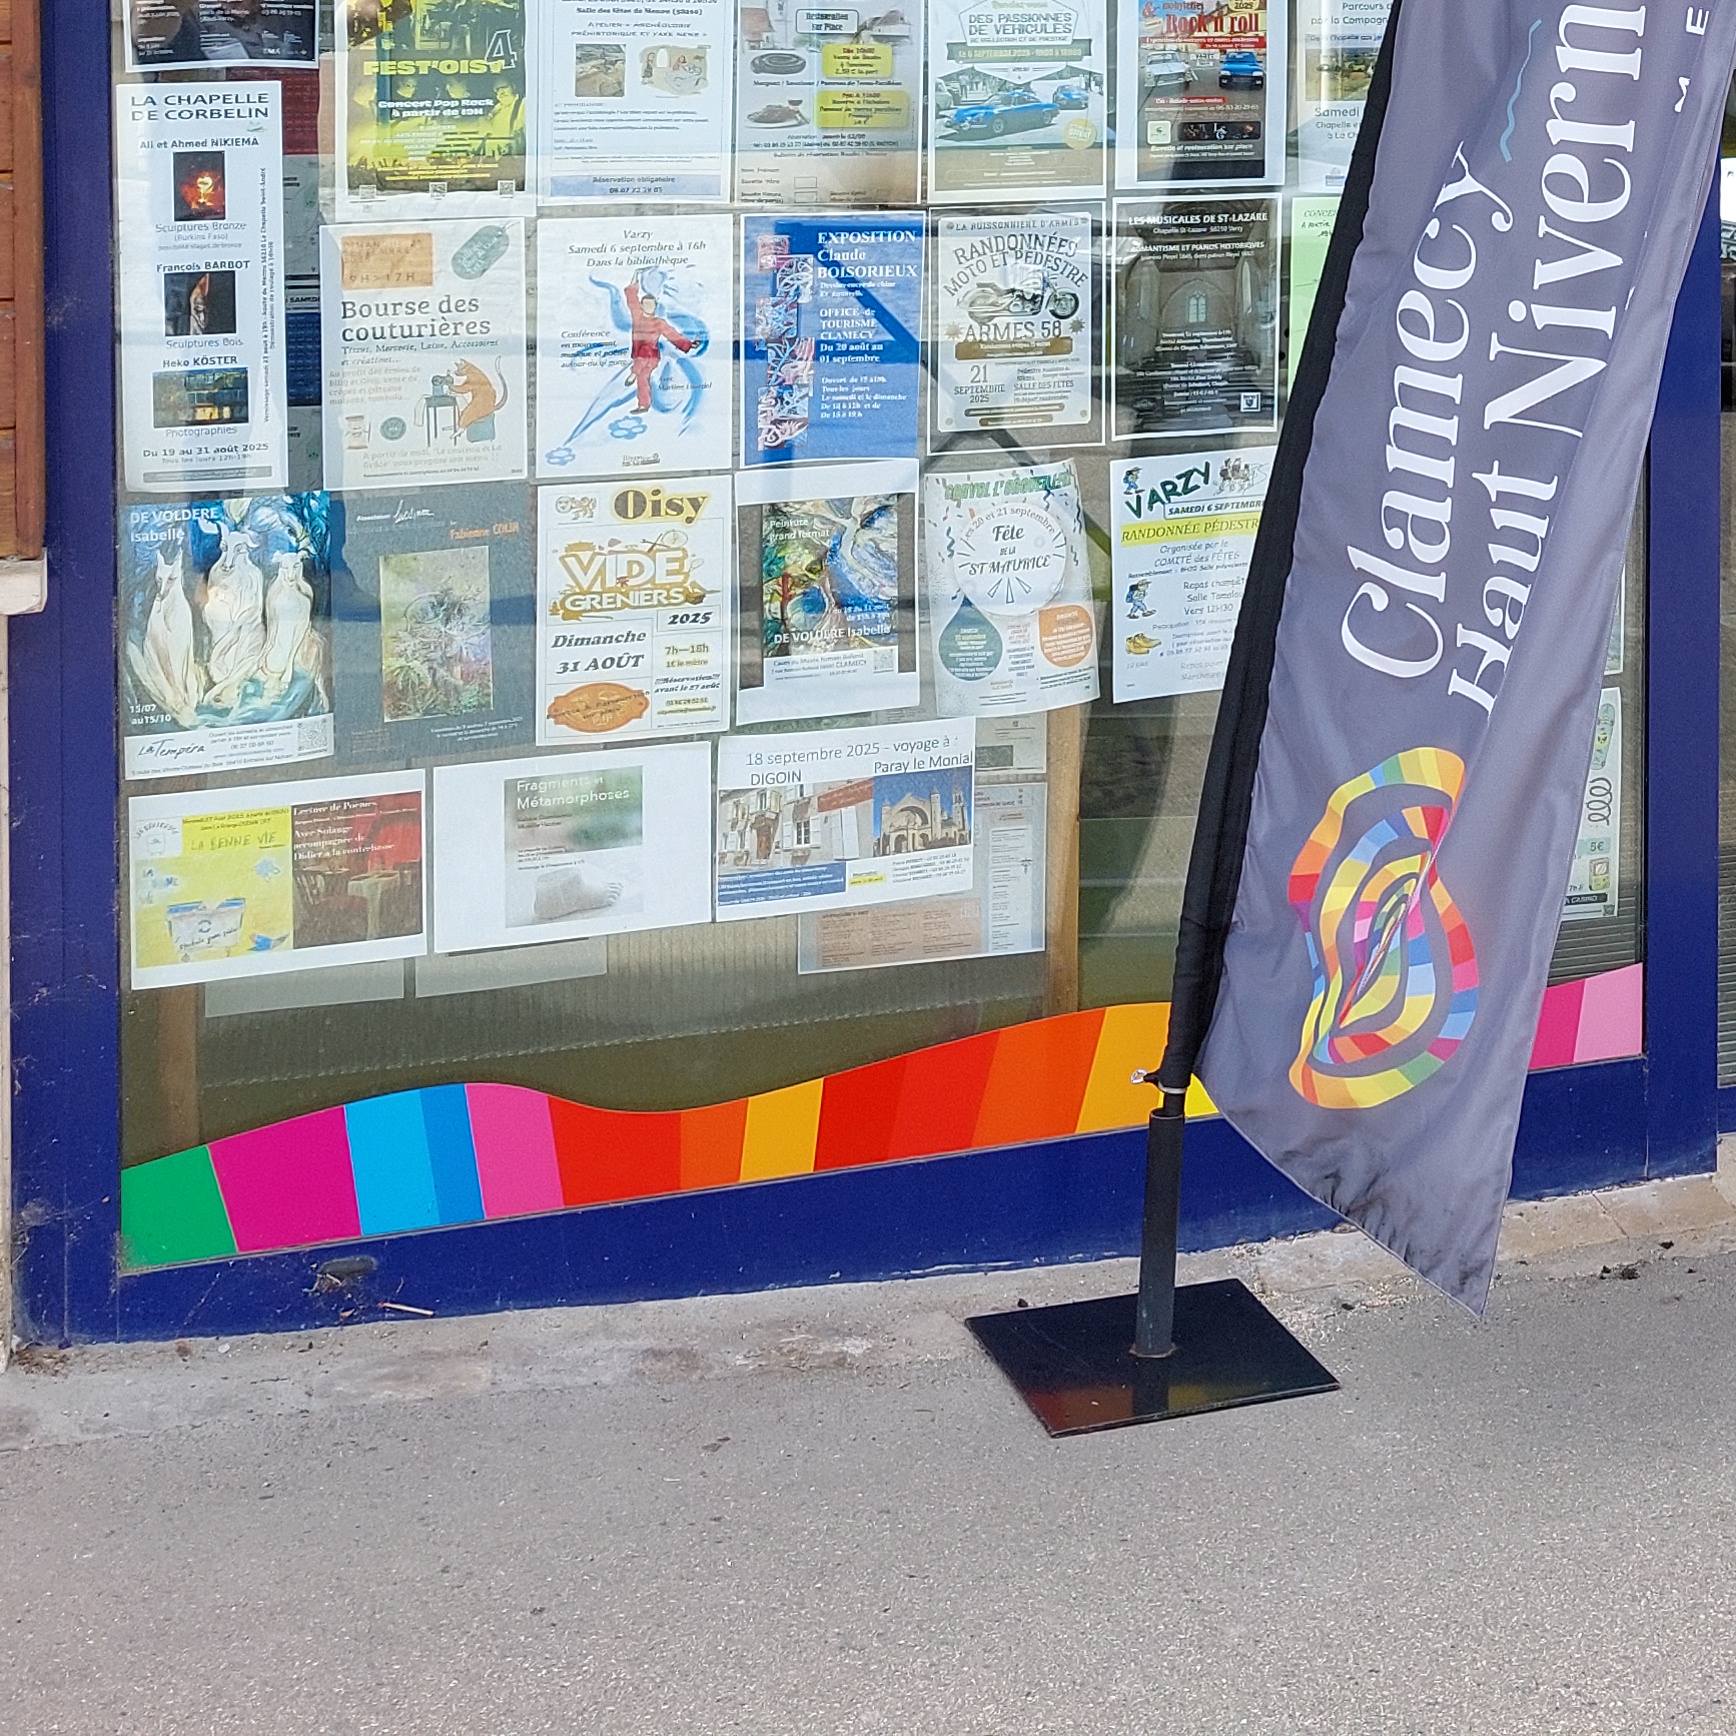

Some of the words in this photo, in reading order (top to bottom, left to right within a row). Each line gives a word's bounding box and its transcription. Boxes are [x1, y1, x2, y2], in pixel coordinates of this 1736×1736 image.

[1235, 2, 1254, 10] 2025
[969, 14, 993, 23] DES
[1164, 13, 1224, 34] Rock'n
[1230, 12, 1259, 34] roll
[363, 60, 505, 75] FEST'OISY
[132, 96, 157, 106] LA
[164, 93, 269, 106] CHAPELLE
[378, 99, 431, 108] Concert
[434, 99, 458, 109] Pop
[461, 99, 494, 107] Rock
[132, 110, 158, 121] DE
[165, 107, 269, 120] CORBELIN
[1315, 106, 1359, 117] Samedi
[171, 140, 207, 148] Ahmed
[211, 138, 259, 146] NIKIEMA
[156, 223, 208, 232] Sculptures
[213, 222, 246, 230] Bronze
[1129, 216, 1146, 225] LES
[1147, 215, 1200, 224] MUSICALES
[623, 230, 653, 240] Varzy
[817, 230, 917, 244] EXPOSITION
[568, 244, 607, 253] Samedi
[610, 244, 617, 252] 6
[619, 243, 675, 254] septembre
[677, 241, 683, 250] à
[688, 242, 706, 250] 16h
[954, 232, 1078, 264] RANDONNÉES
[587, 257, 612, 267] Dans
[615, 257, 624, 265] la
[626, 256, 688, 266] bibliothèque
[817, 250, 866, 262] Claude
[157, 263, 200, 273] François
[205, 261, 250, 270] BARBOT
[817, 266, 918, 278] BOISORIEUX
[341, 300, 430, 319] Bourse
[439, 295, 479, 313] des
[342, 316, 491, 342] couturières
[821, 320, 877, 328] TOURISME
[966, 322, 1034, 341] ARMES
[1041, 320, 1061, 337] 58
[561, 330, 610, 338] Conférence
[820, 331, 875, 339] CLAMECY
[166, 339, 220, 349] Sculptures
[223, 338, 243, 347] Bois
[971, 365, 988, 383] 21
[954, 385, 1005, 394] SEPTEMBRE
[970, 394, 989, 403] 2025
[1341, 141, 1513, 677] Clamecy
[166, 427, 237, 437] Photographies
[1125, 461, 1211, 518] VARZY
[613, 488, 708, 524] Oisy
[1168, 504, 1205, 515] SAMEDI
[1214, 500, 1265, 510] SEPTEMBR
[130, 512, 149, 524] DE
[150, 508, 218, 522] VOLDERE
[130, 530, 185, 542] Isabelle
[992, 525, 1025, 542] Fête
[1121, 522, 1200, 542] RANDONNÉE
[1204, 518, 1259, 532] PÉDESTR
[1160, 542, 1201, 553] Organisée
[1205, 541, 1220, 550] par
[969, 562, 988, 576] ST
[988, 555, 1050, 574] MAURICE
[1155, 554, 1192, 567] COMITÉ
[1194, 554, 1209, 563] des
[1212, 550, 1239, 561] FÊTES
[562, 549, 686, 590] VIDE
[1183, 581, 1208, 590] Repas
[1447, 459, 1559, 720] Haut
[565, 589, 686, 611] GRENIERS
[1186, 593, 1207, 602] Salle
[668, 612, 713, 625] 2025
[551, 630, 646, 648] Dimanche
[774, 634, 789, 643] DE
[792, 629, 845, 642] VOLDERE
[848, 626, 890, 636] Isabelle
[556, 662, 581, 674] 31
[585, 652, 644, 671] AOÛT
[746, 752, 764, 766] 18
[767, 746, 842, 766] septembre
[847, 743, 880, 757] 2025
[893, 739, 939, 756] voyage
[943, 735, 950, 748] à
[874, 758, 910, 774] Paray
[913, 756, 926, 769] le
[929, 750, 973, 768] Monial
[751, 770, 802, 786] DIGOIN
[517, 789, 630, 809] Métamorphoses
